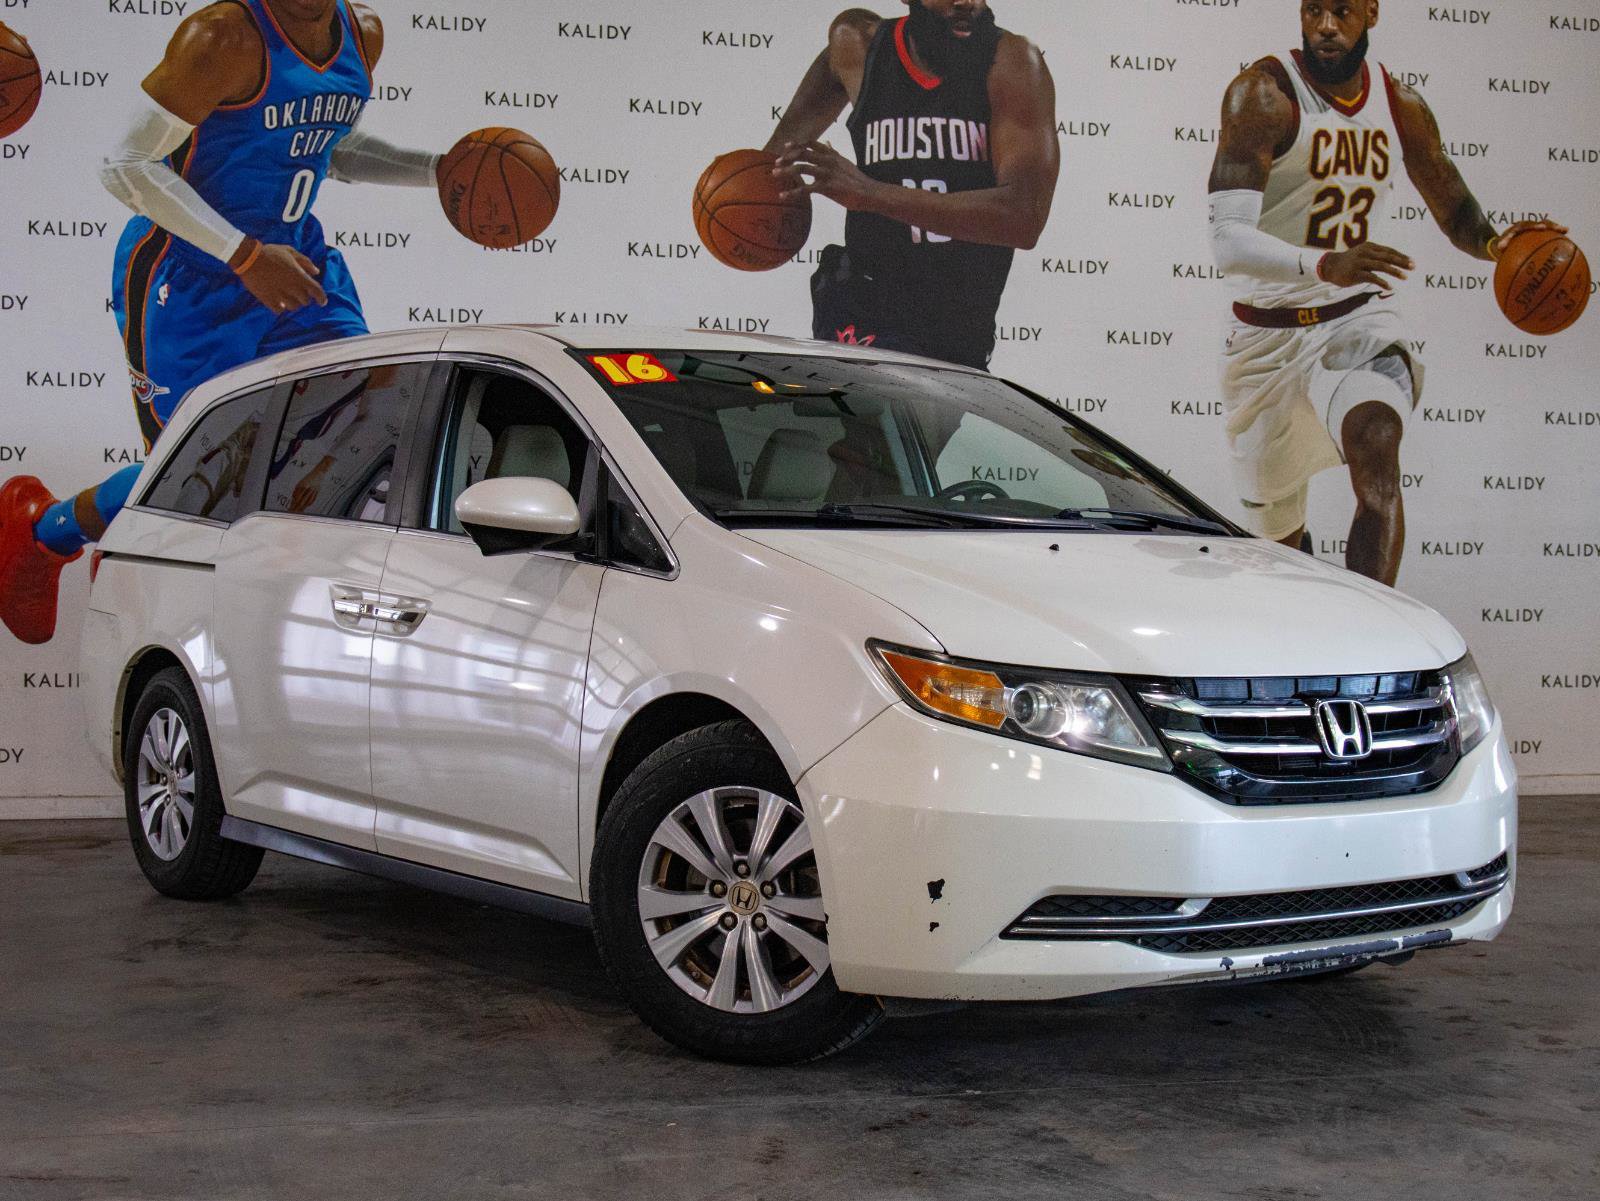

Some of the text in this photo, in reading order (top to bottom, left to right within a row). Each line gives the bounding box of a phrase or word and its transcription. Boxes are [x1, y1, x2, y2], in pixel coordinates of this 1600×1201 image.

[109, 0, 189, 16] KALIDY
[1429, 8, 1490, 24] KALIDY
[413, 14, 486, 32] KALIDY
[1550, 16, 1600, 32] KALID
[559, 23, 631, 40] KALIDY
[703, 31, 773, 48] KALIDY
[1111, 55, 1176, 71] KALIDY
[45, 71, 109, 87] ALIDY
[1489, 78, 1550, 94] KALIDY
[485, 91, 558, 108] KALIDY
[630, 99, 702, 115] KALIDY
[264, 93, 363, 129] OKLAHOM
[1057, 122, 1110, 136] ALIDY
[289, 129, 335, 157] CITY
[865, 117, 988, 165] HOUSTON
[1310, 128, 1389, 181] CAVS
[1548, 147, 1600, 163] KALID
[282, 169, 315, 223] 0
[1109, 193, 1174, 208] KALIDY
[1304, 184, 1376, 251] 23
[29, 221, 107, 237] KALIDY
[335, 232, 410, 248] KALIDY
[629, 242, 700, 258] KALIDY
[1043, 259, 1108, 274] KALIDY
[1426, 275, 1487, 289] KALIDY
[409, 307, 483, 323] KALIDY
[1297, 307, 1320, 325] CLE
[698, 317, 769, 332] KALIDY
[1108, 330, 1172, 345] KALIDY
[1486, 344, 1547, 358] KALIDY
[593, 354, 667, 383] 16
[27, 371, 105, 387] KALIDY
[1172, 401, 1222, 415] KALID
[1424, 408, 1485, 422] KALIDY
[972, 466, 1039, 480] KALIDY
[1484, 476, 1545, 490] KALIDY
[1422, 542, 1484, 555] KALIDY
[1482, 609, 1543, 622] KALIDY
[1542, 675, 1600, 688] KALIDY
